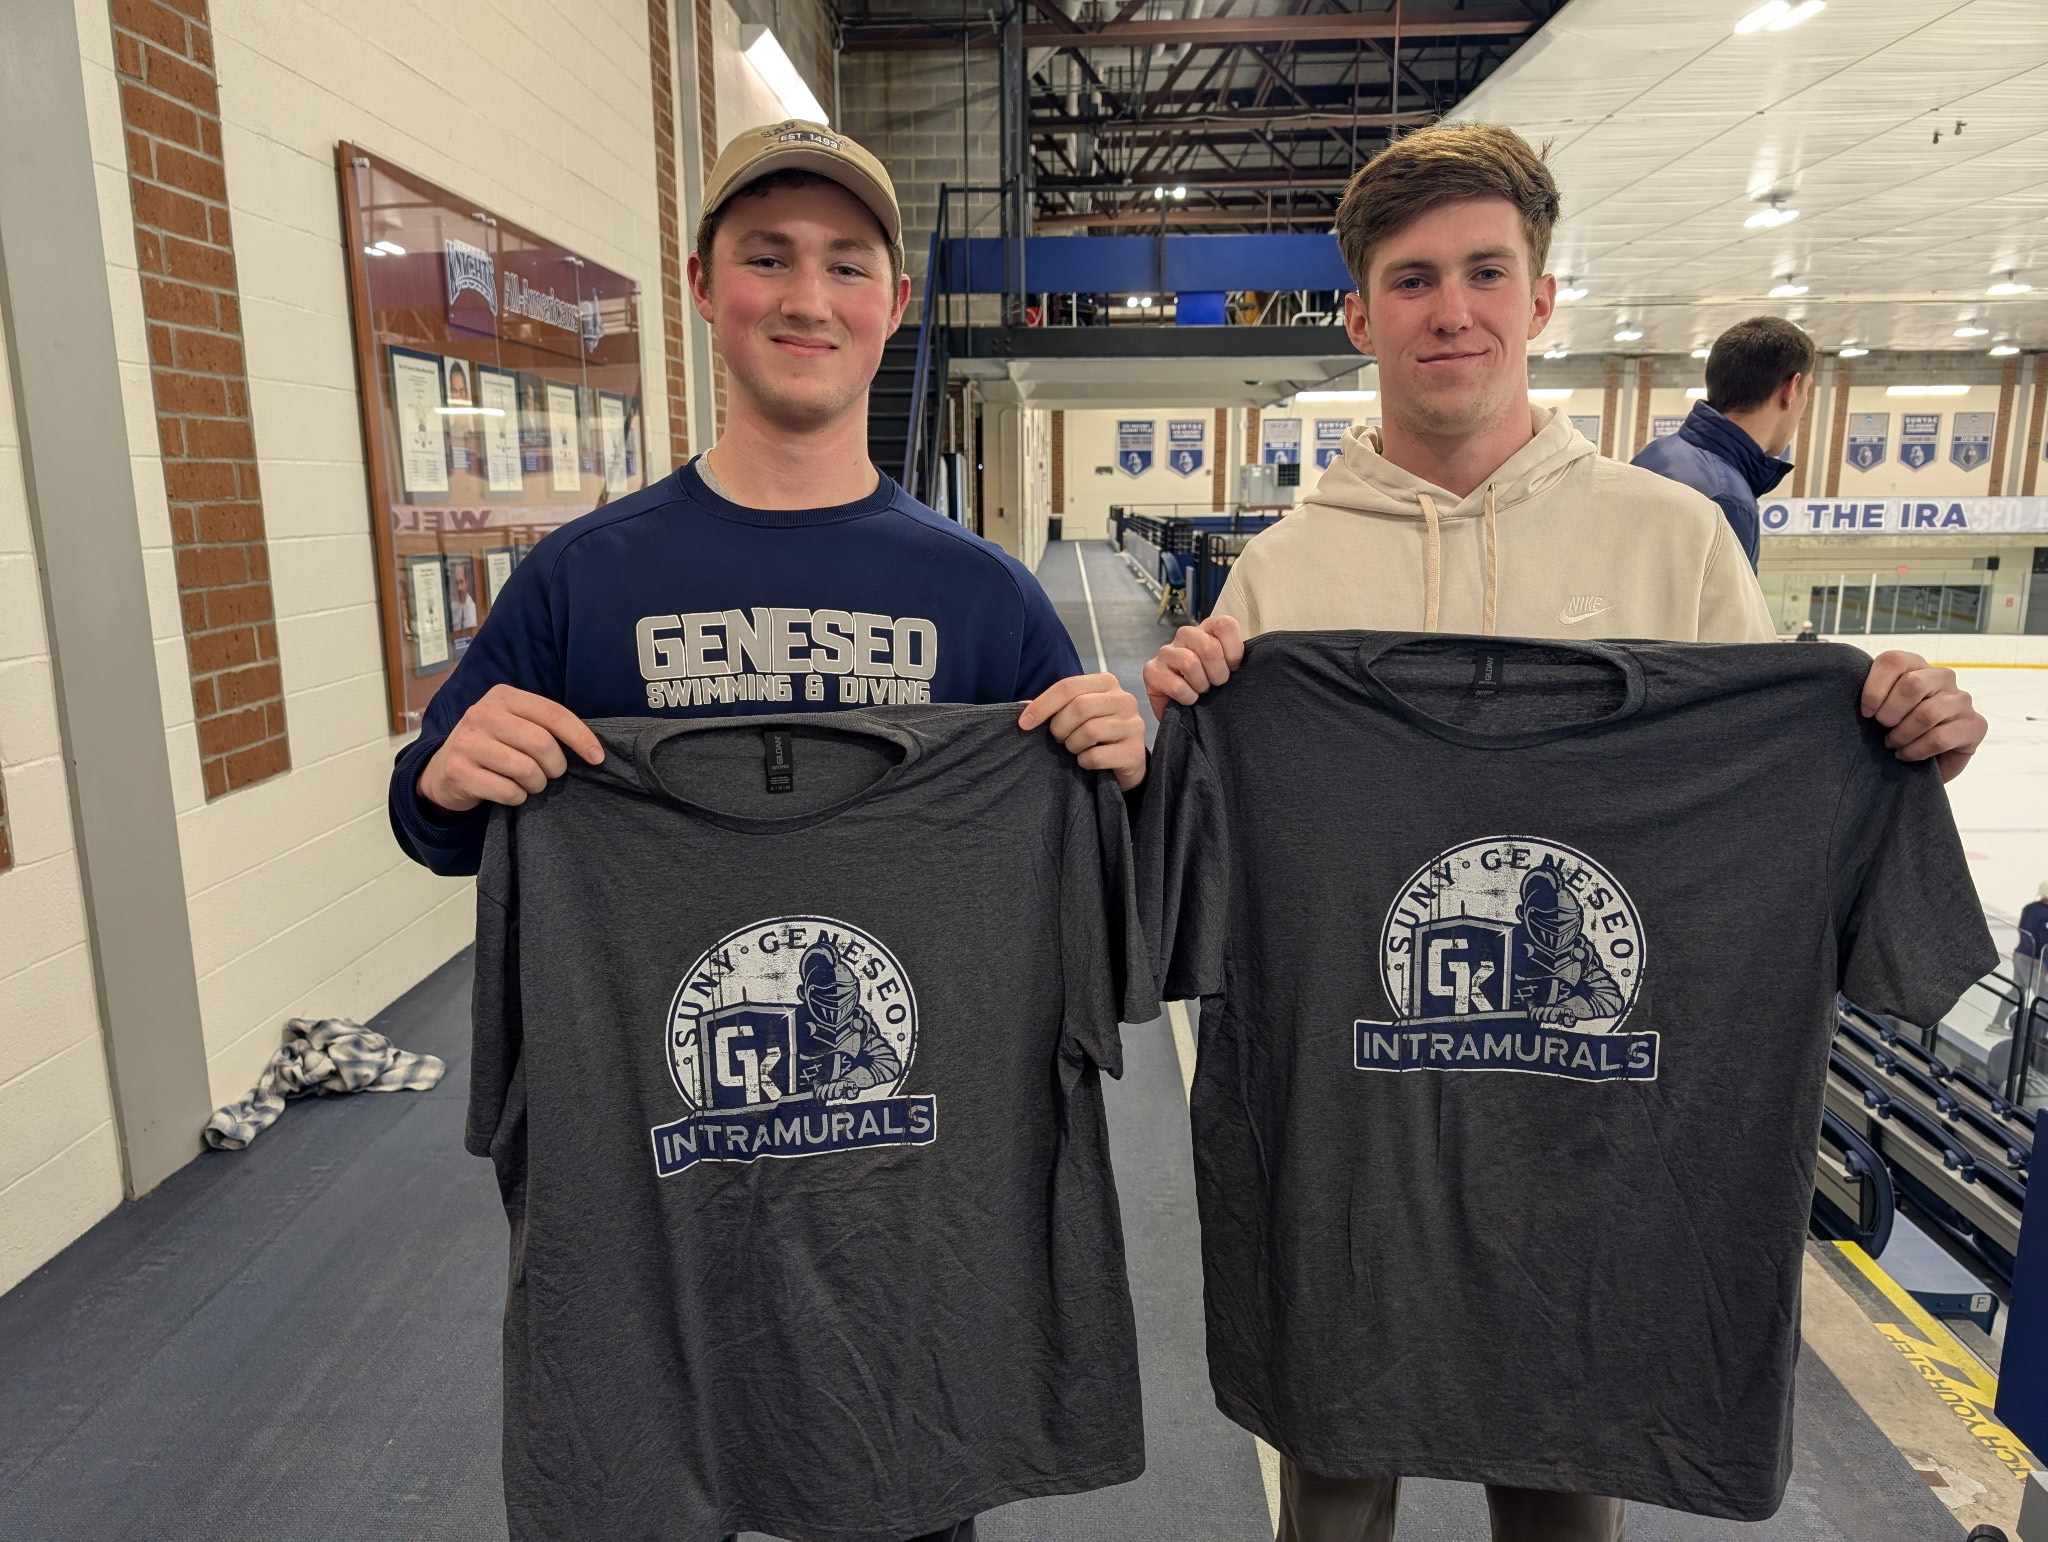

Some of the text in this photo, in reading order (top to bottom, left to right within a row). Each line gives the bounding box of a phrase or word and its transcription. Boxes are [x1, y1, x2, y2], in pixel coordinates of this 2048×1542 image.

[810, 133, 838, 149] 1493
[1763, 504, 1789, 530] O
[1807, 504, 1885, 529] THE
[1900, 503, 1968, 528] IRA
[1567, 596, 1603, 612] NIKE
[636, 607, 938, 680] GENESEO
[646, 674, 930, 709] SWIMMING & DIVING
[775, 736, 784, 765] GILDAN
[1389, 848, 1635, 960] SUNY GENESEO
[675, 927, 908, 1047] SUNY GENESEO
[1427, 938, 1495, 1015] GK
[715, 1025, 783, 1104] GK
[1362, 1031, 1651, 1071] INTRAMURALS
[662, 1104, 931, 1165] INTRAMURALS
[1976, 1296, 1987, 1309] F
[1884, 1333, 2031, 1478] TCH YOUR STEP
